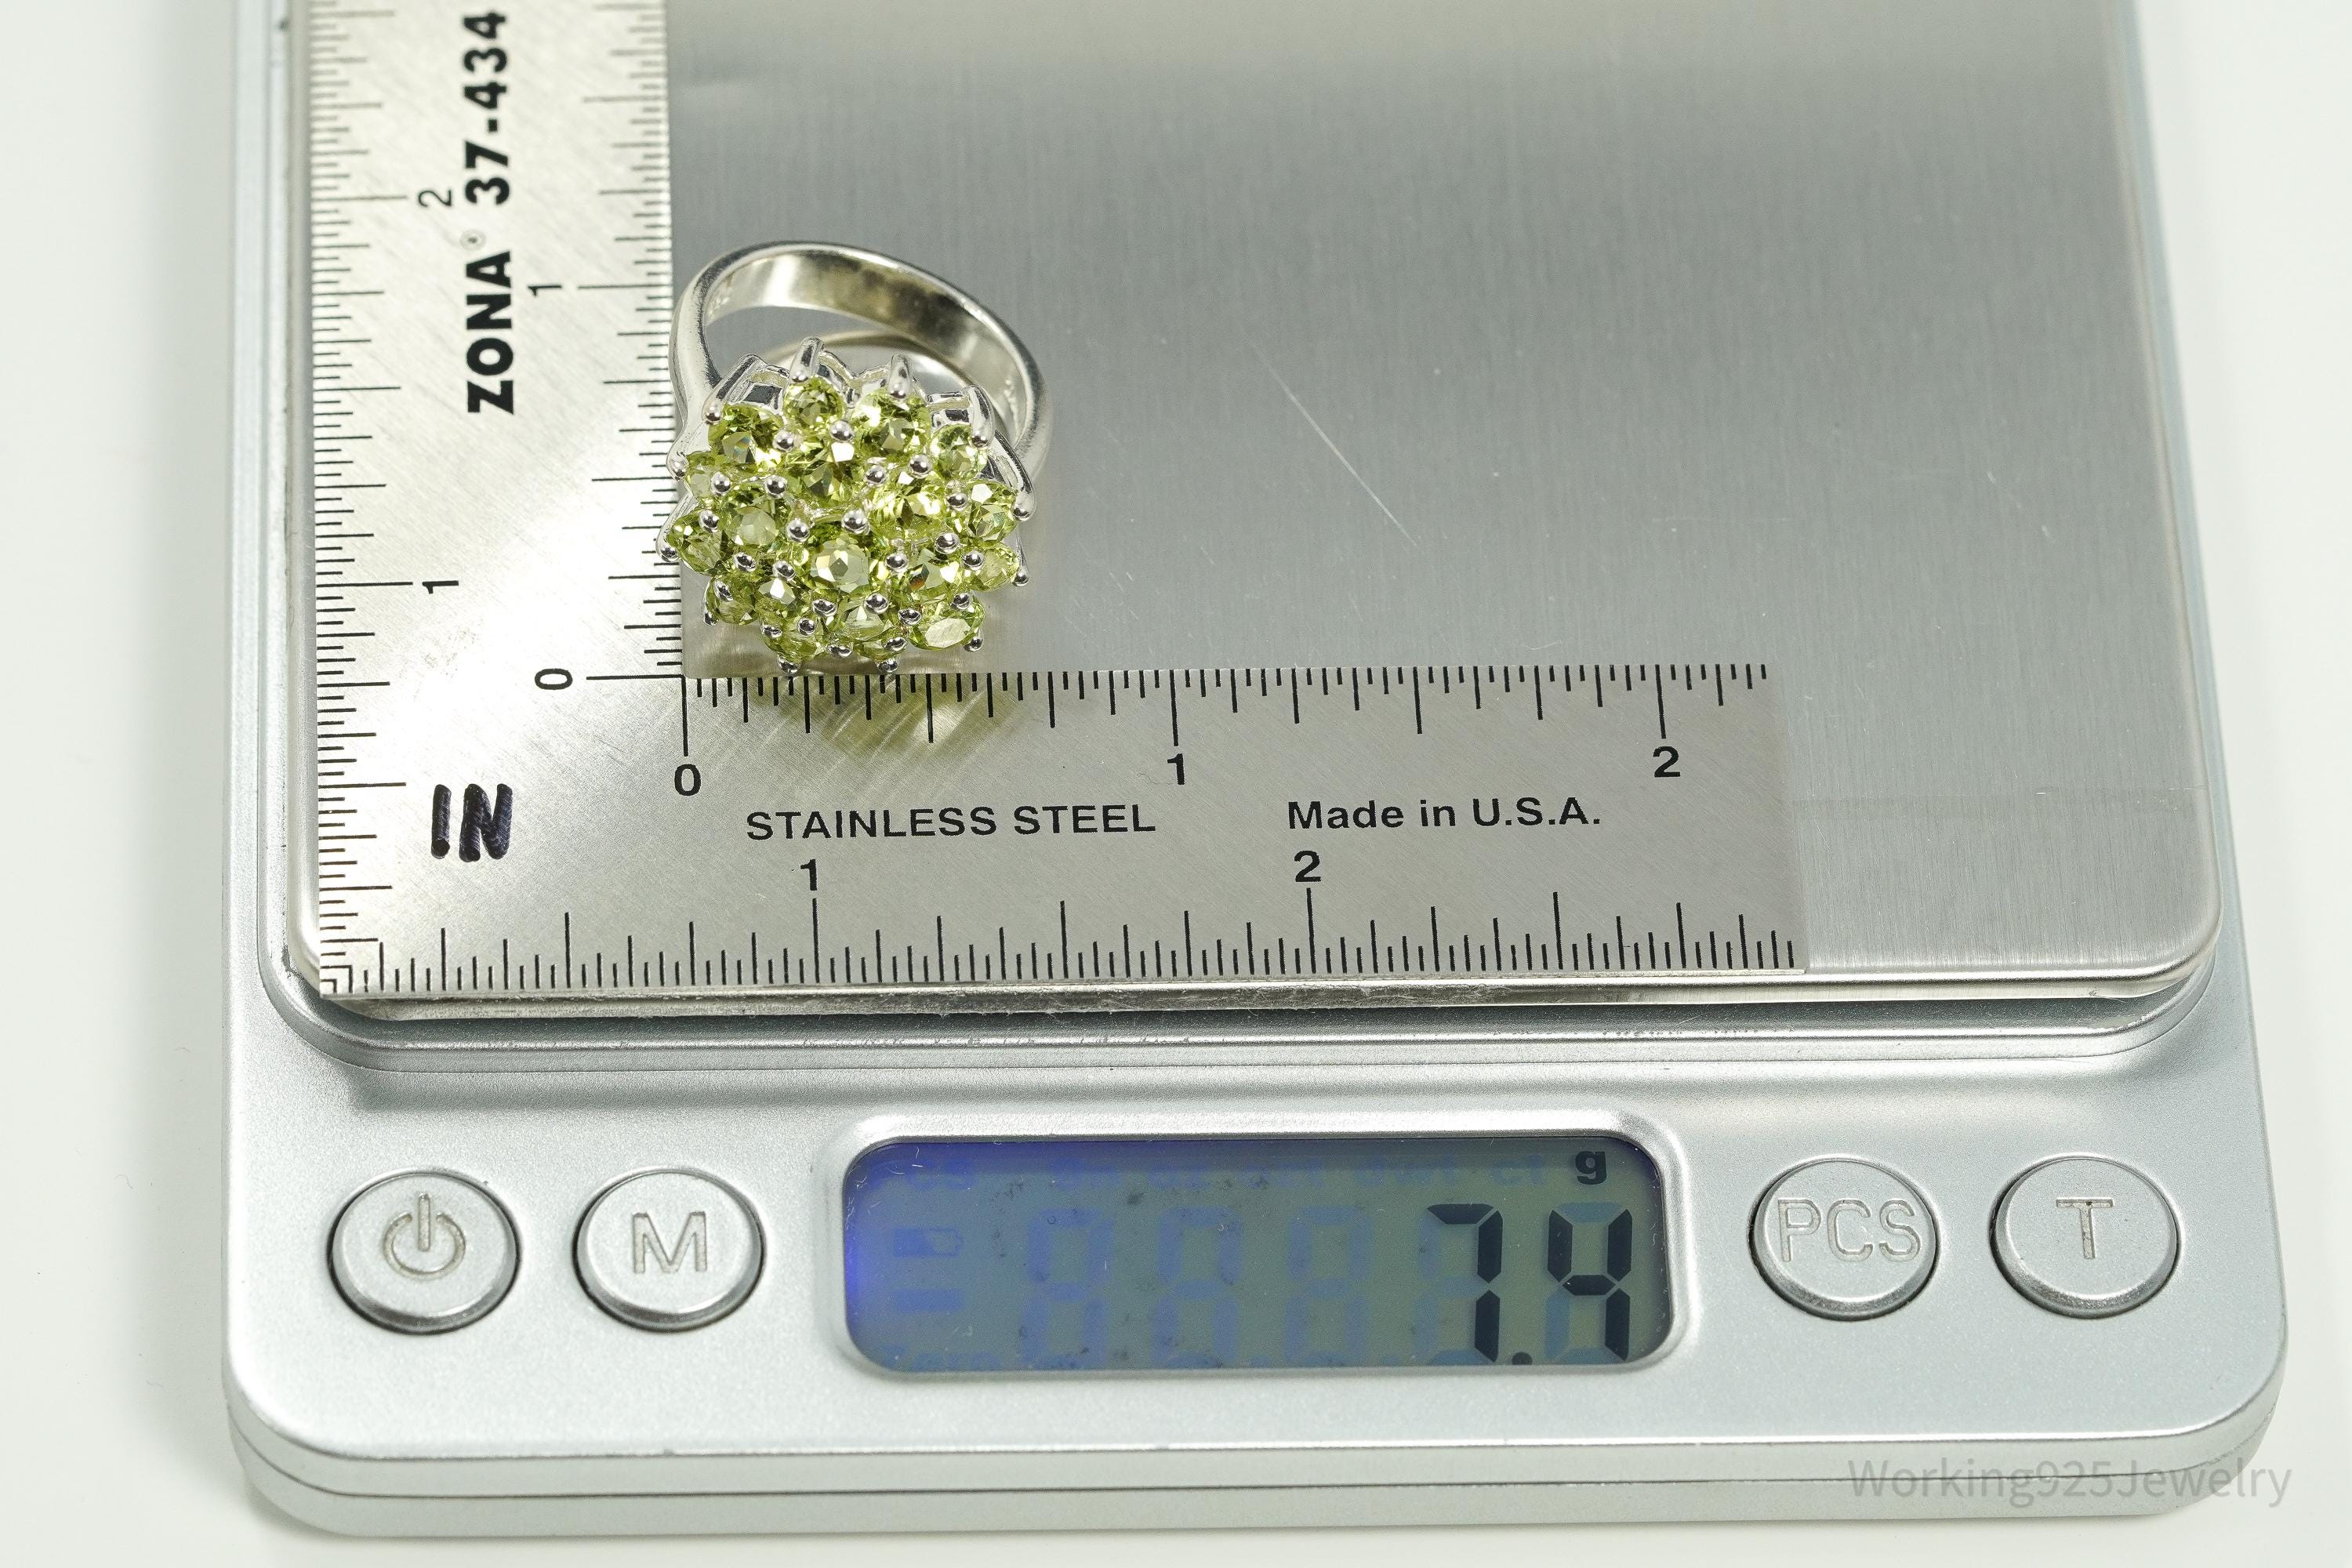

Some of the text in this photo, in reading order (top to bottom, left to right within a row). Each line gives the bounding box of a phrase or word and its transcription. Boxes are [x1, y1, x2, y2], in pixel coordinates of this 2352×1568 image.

[417, 188, 453, 208] 2
[463, 11, 515, 416] ZONA 37-434
[527, 283, 562, 296] 1
[422, 580, 459, 593] 1
[534, 667, 573, 690] 0
[1167, 753, 1185, 785] 1
[1652, 746, 1681, 779] 2
[673, 763, 702, 797] 0
[430, 782, 514, 862] IN
[746, 803, 1156, 841] STAINLESS STEEL
[1287, 796, 1602, 831] Made in U.S.A.
[799, 858, 818, 891] 1
[1294, 850, 1322, 883] 2
[1574, 1149, 1608, 1185] g
[631, 1211, 709, 1274] M
[1776, 1198, 1922, 1264] PCS
[2055, 1197, 2114, 1260] T
[1425, 1203, 1632, 1366] 7.4
